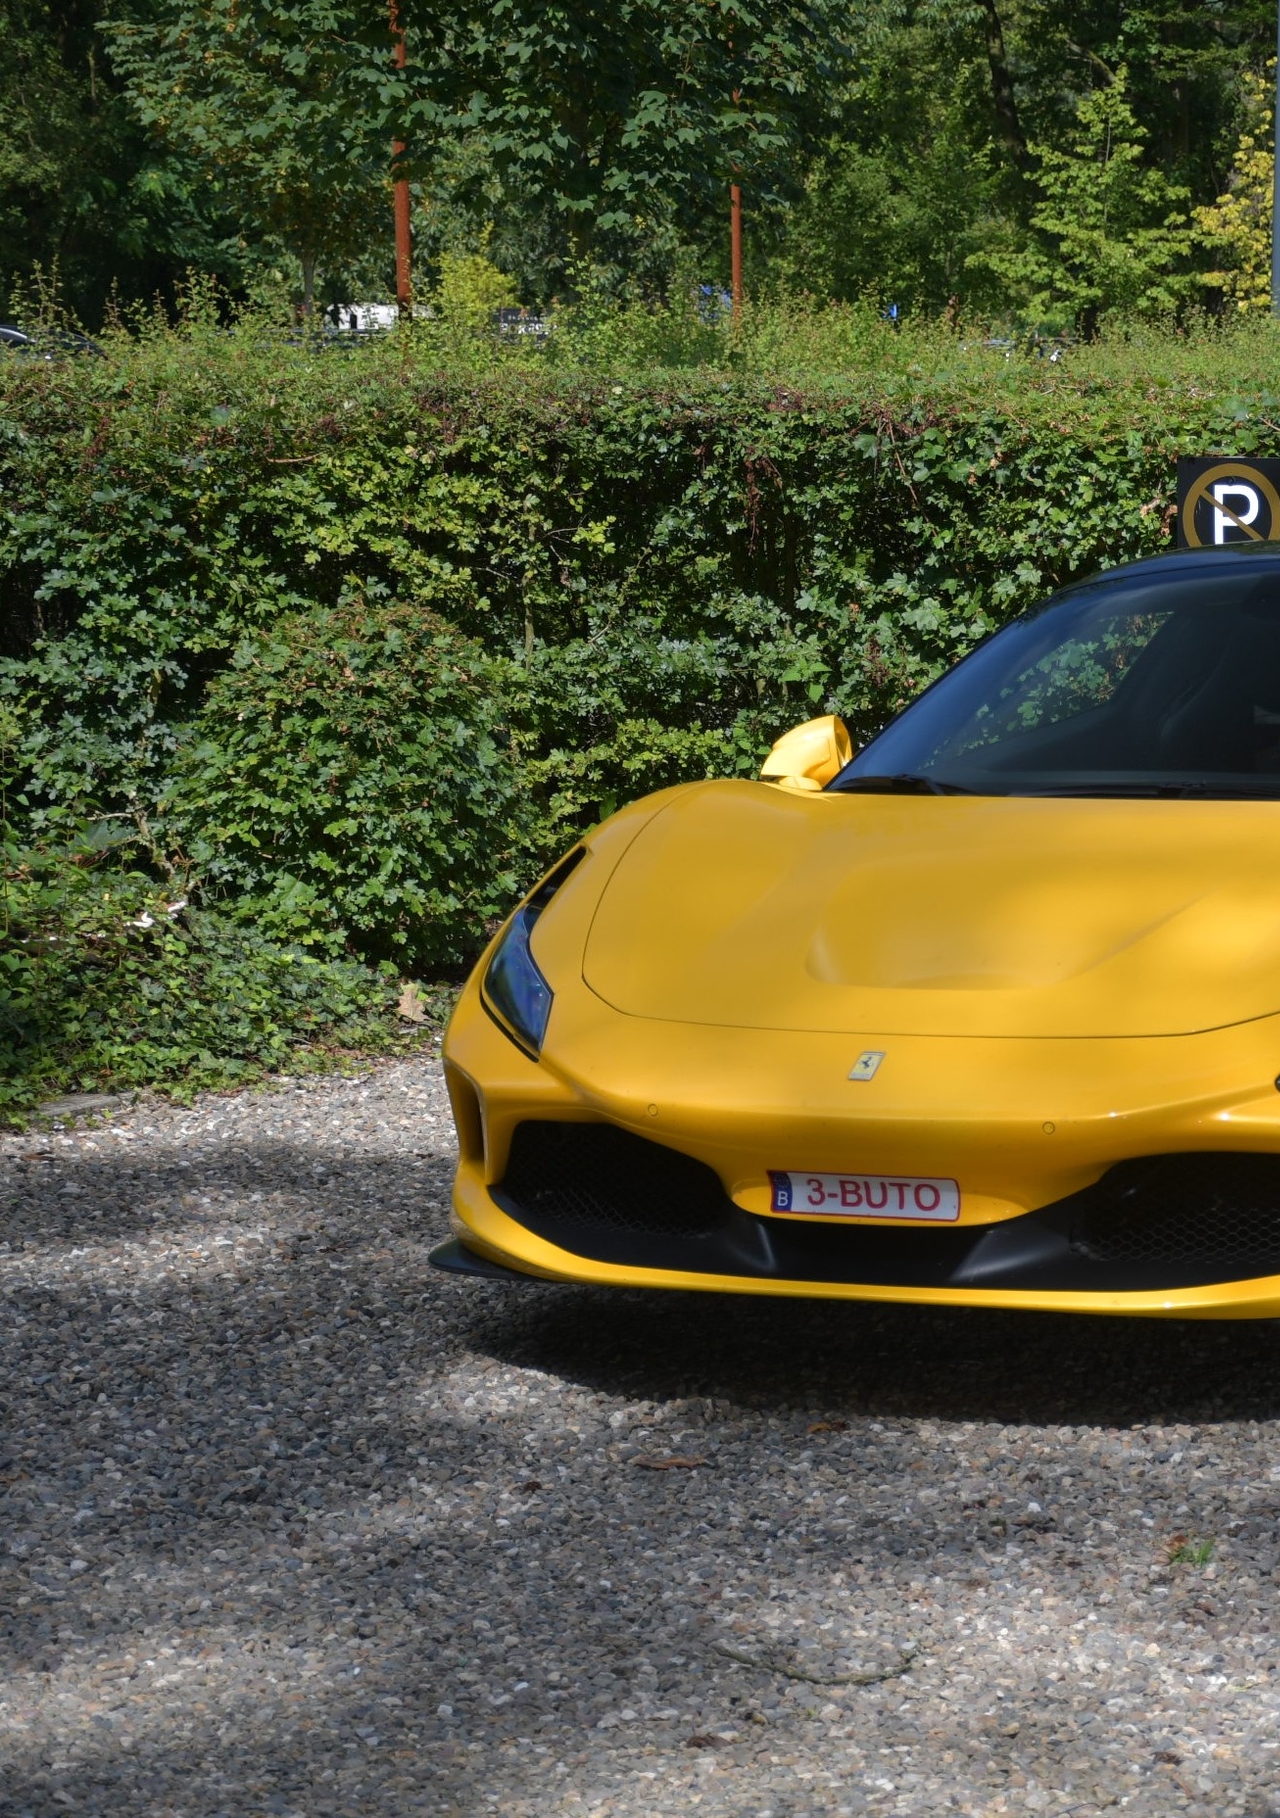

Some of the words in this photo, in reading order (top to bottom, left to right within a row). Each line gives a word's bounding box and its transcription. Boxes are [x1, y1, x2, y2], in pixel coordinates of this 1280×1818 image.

[1214, 484, 1259, 544] P
[777, 1191, 789, 1206] B
[806, 1178, 941, 1212] 3-BUTO
